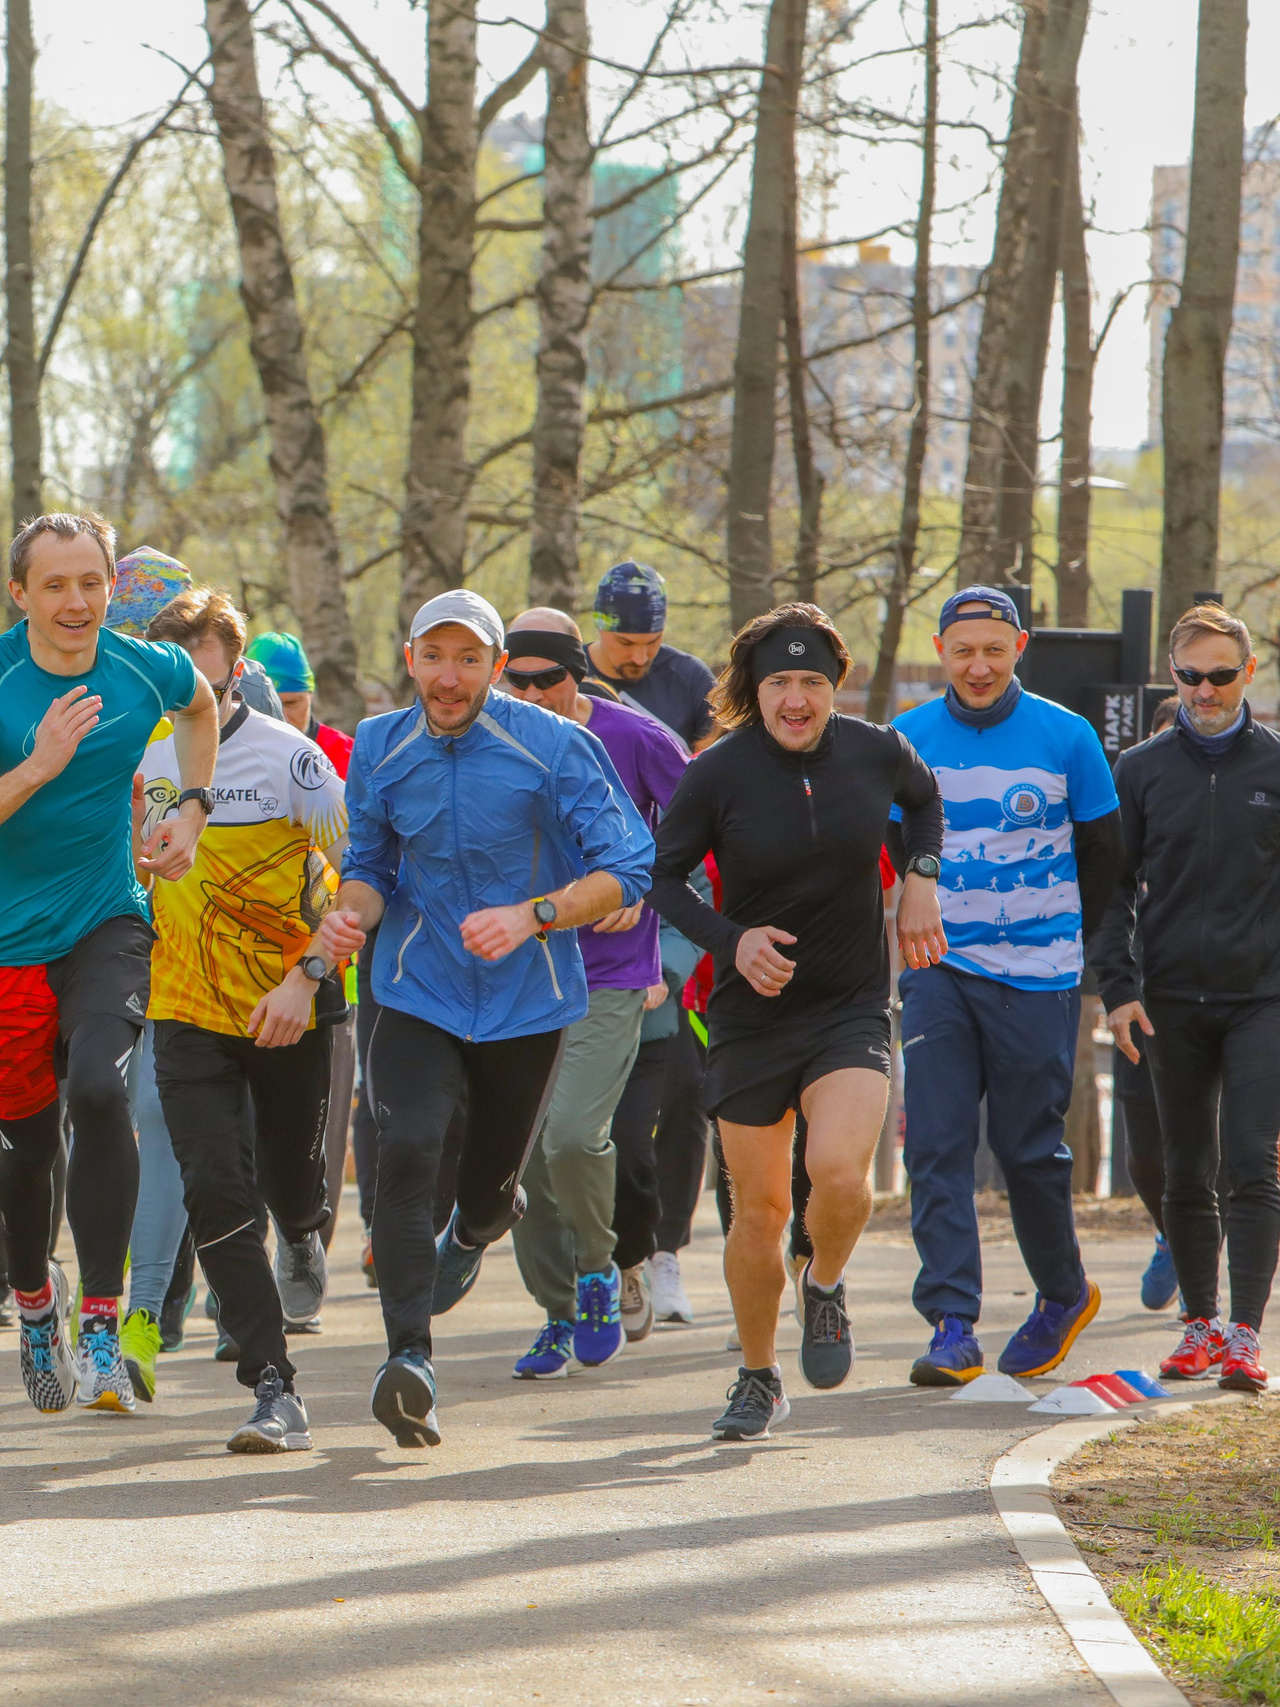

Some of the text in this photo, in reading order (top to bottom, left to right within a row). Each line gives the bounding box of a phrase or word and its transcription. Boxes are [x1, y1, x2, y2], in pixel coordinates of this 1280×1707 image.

[1104, 694, 1120, 751] ПАРК
[1121, 694, 1134, 737] PARK
[90, 1304, 117, 1313] FILA
